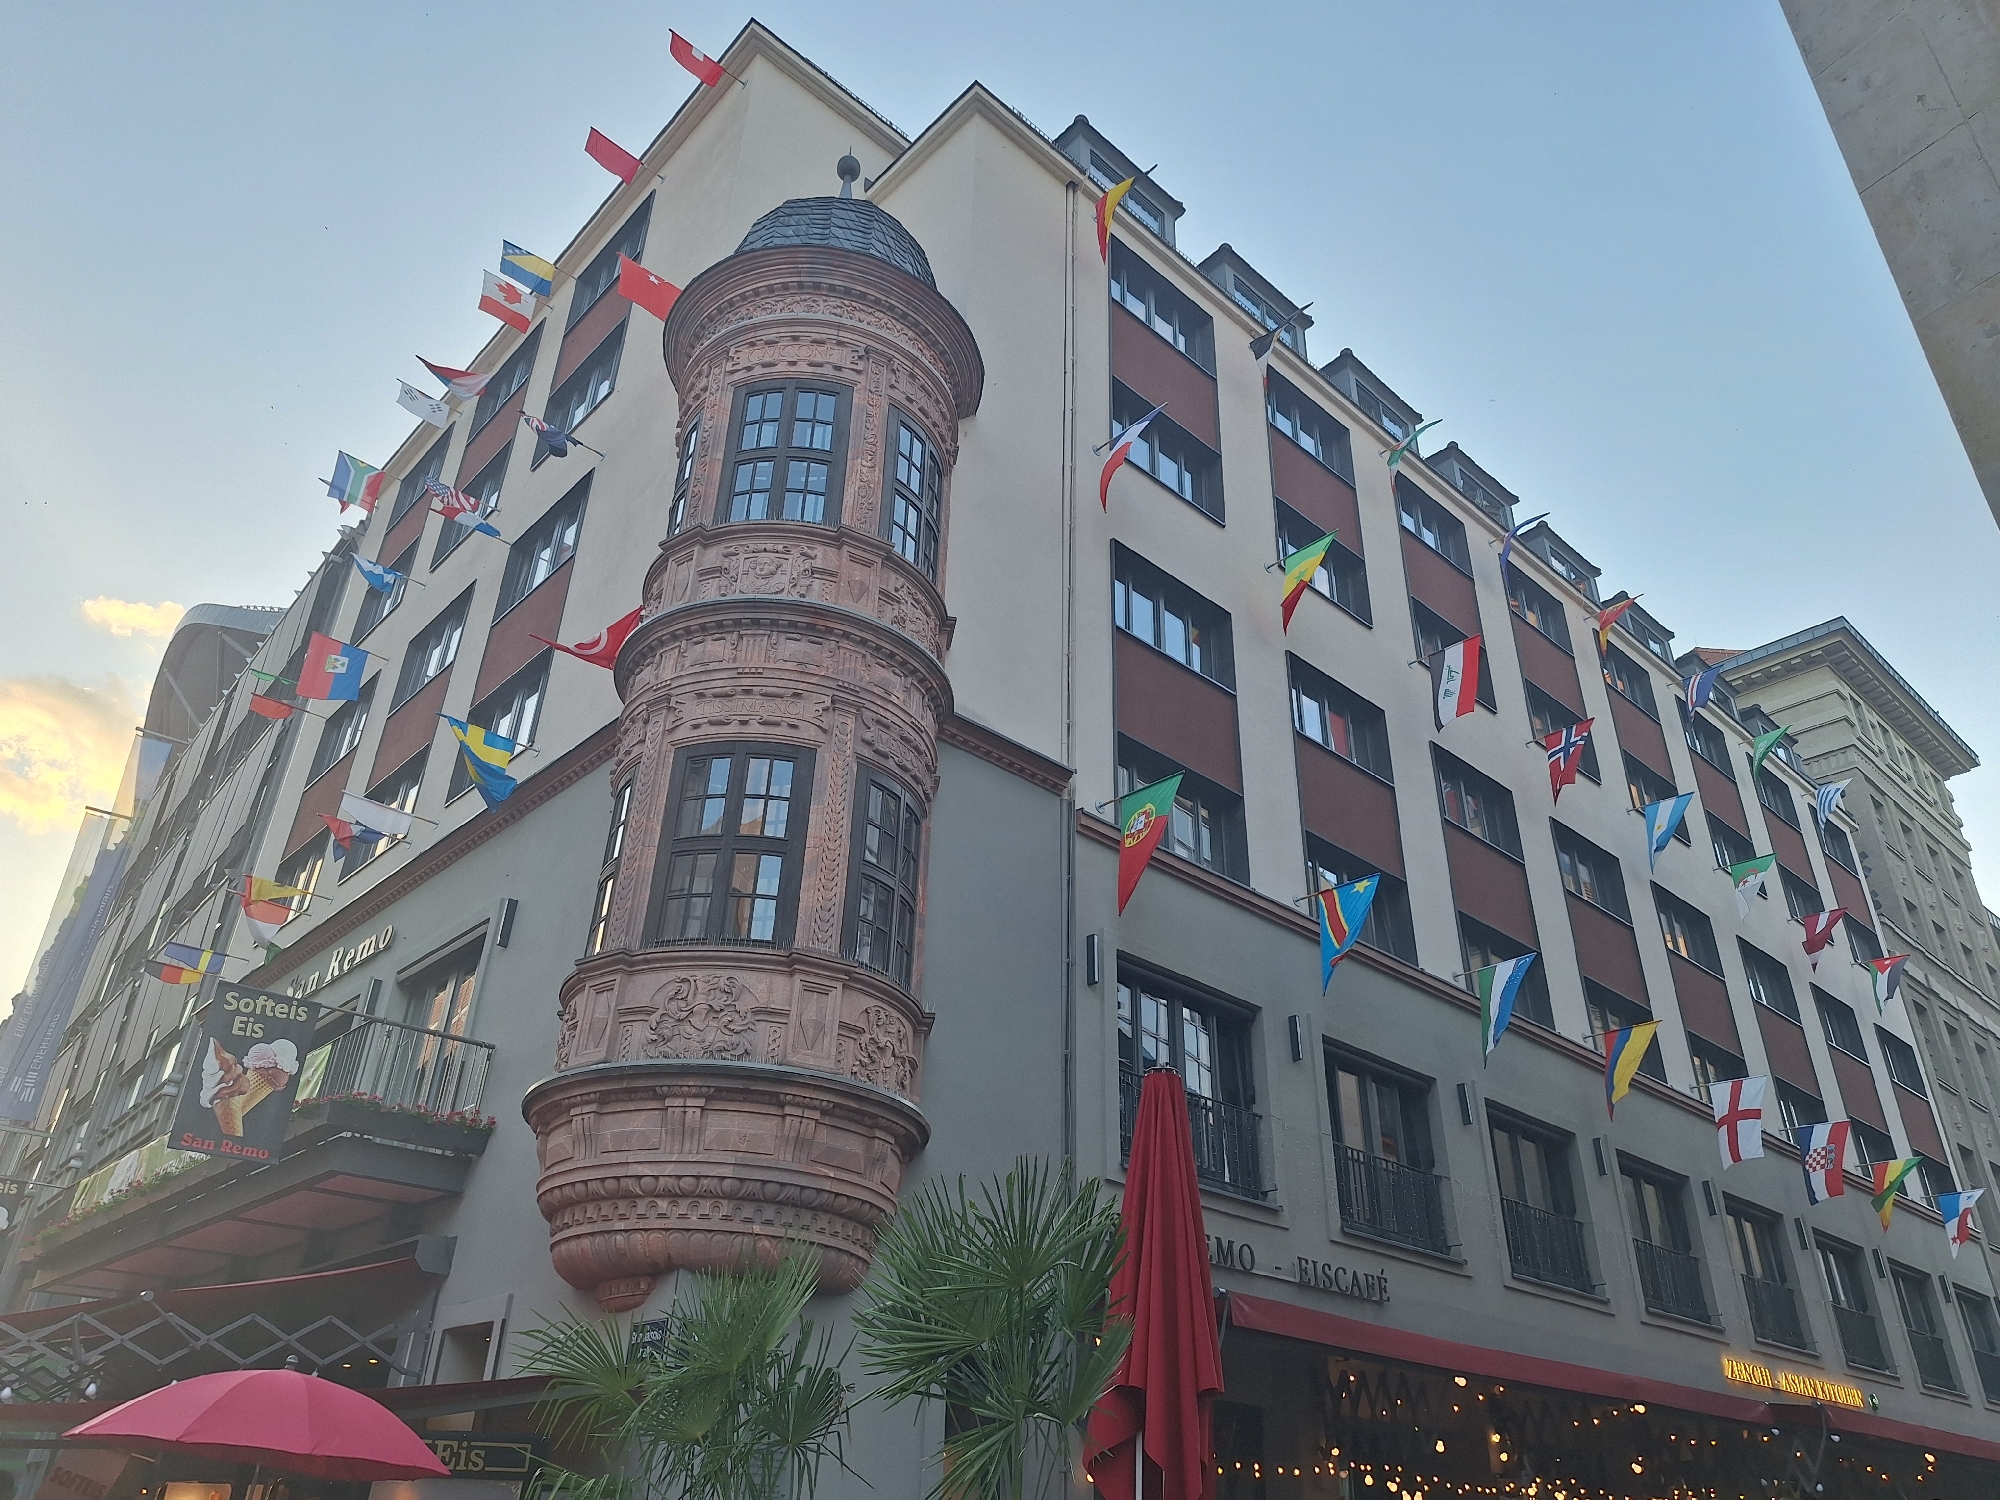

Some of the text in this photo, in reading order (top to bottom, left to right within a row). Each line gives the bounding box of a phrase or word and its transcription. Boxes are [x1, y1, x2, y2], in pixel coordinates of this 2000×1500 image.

[323, 924, 394, 985] Remo
[223, 991, 309, 1022] Softeis
[231, 1015, 265, 1039] Eis
[180, 1132, 270, 1160] San Remo
[1297, 1256, 1391, 1303] EISCAFÉ
[434, 1440, 486, 1472] Eis
